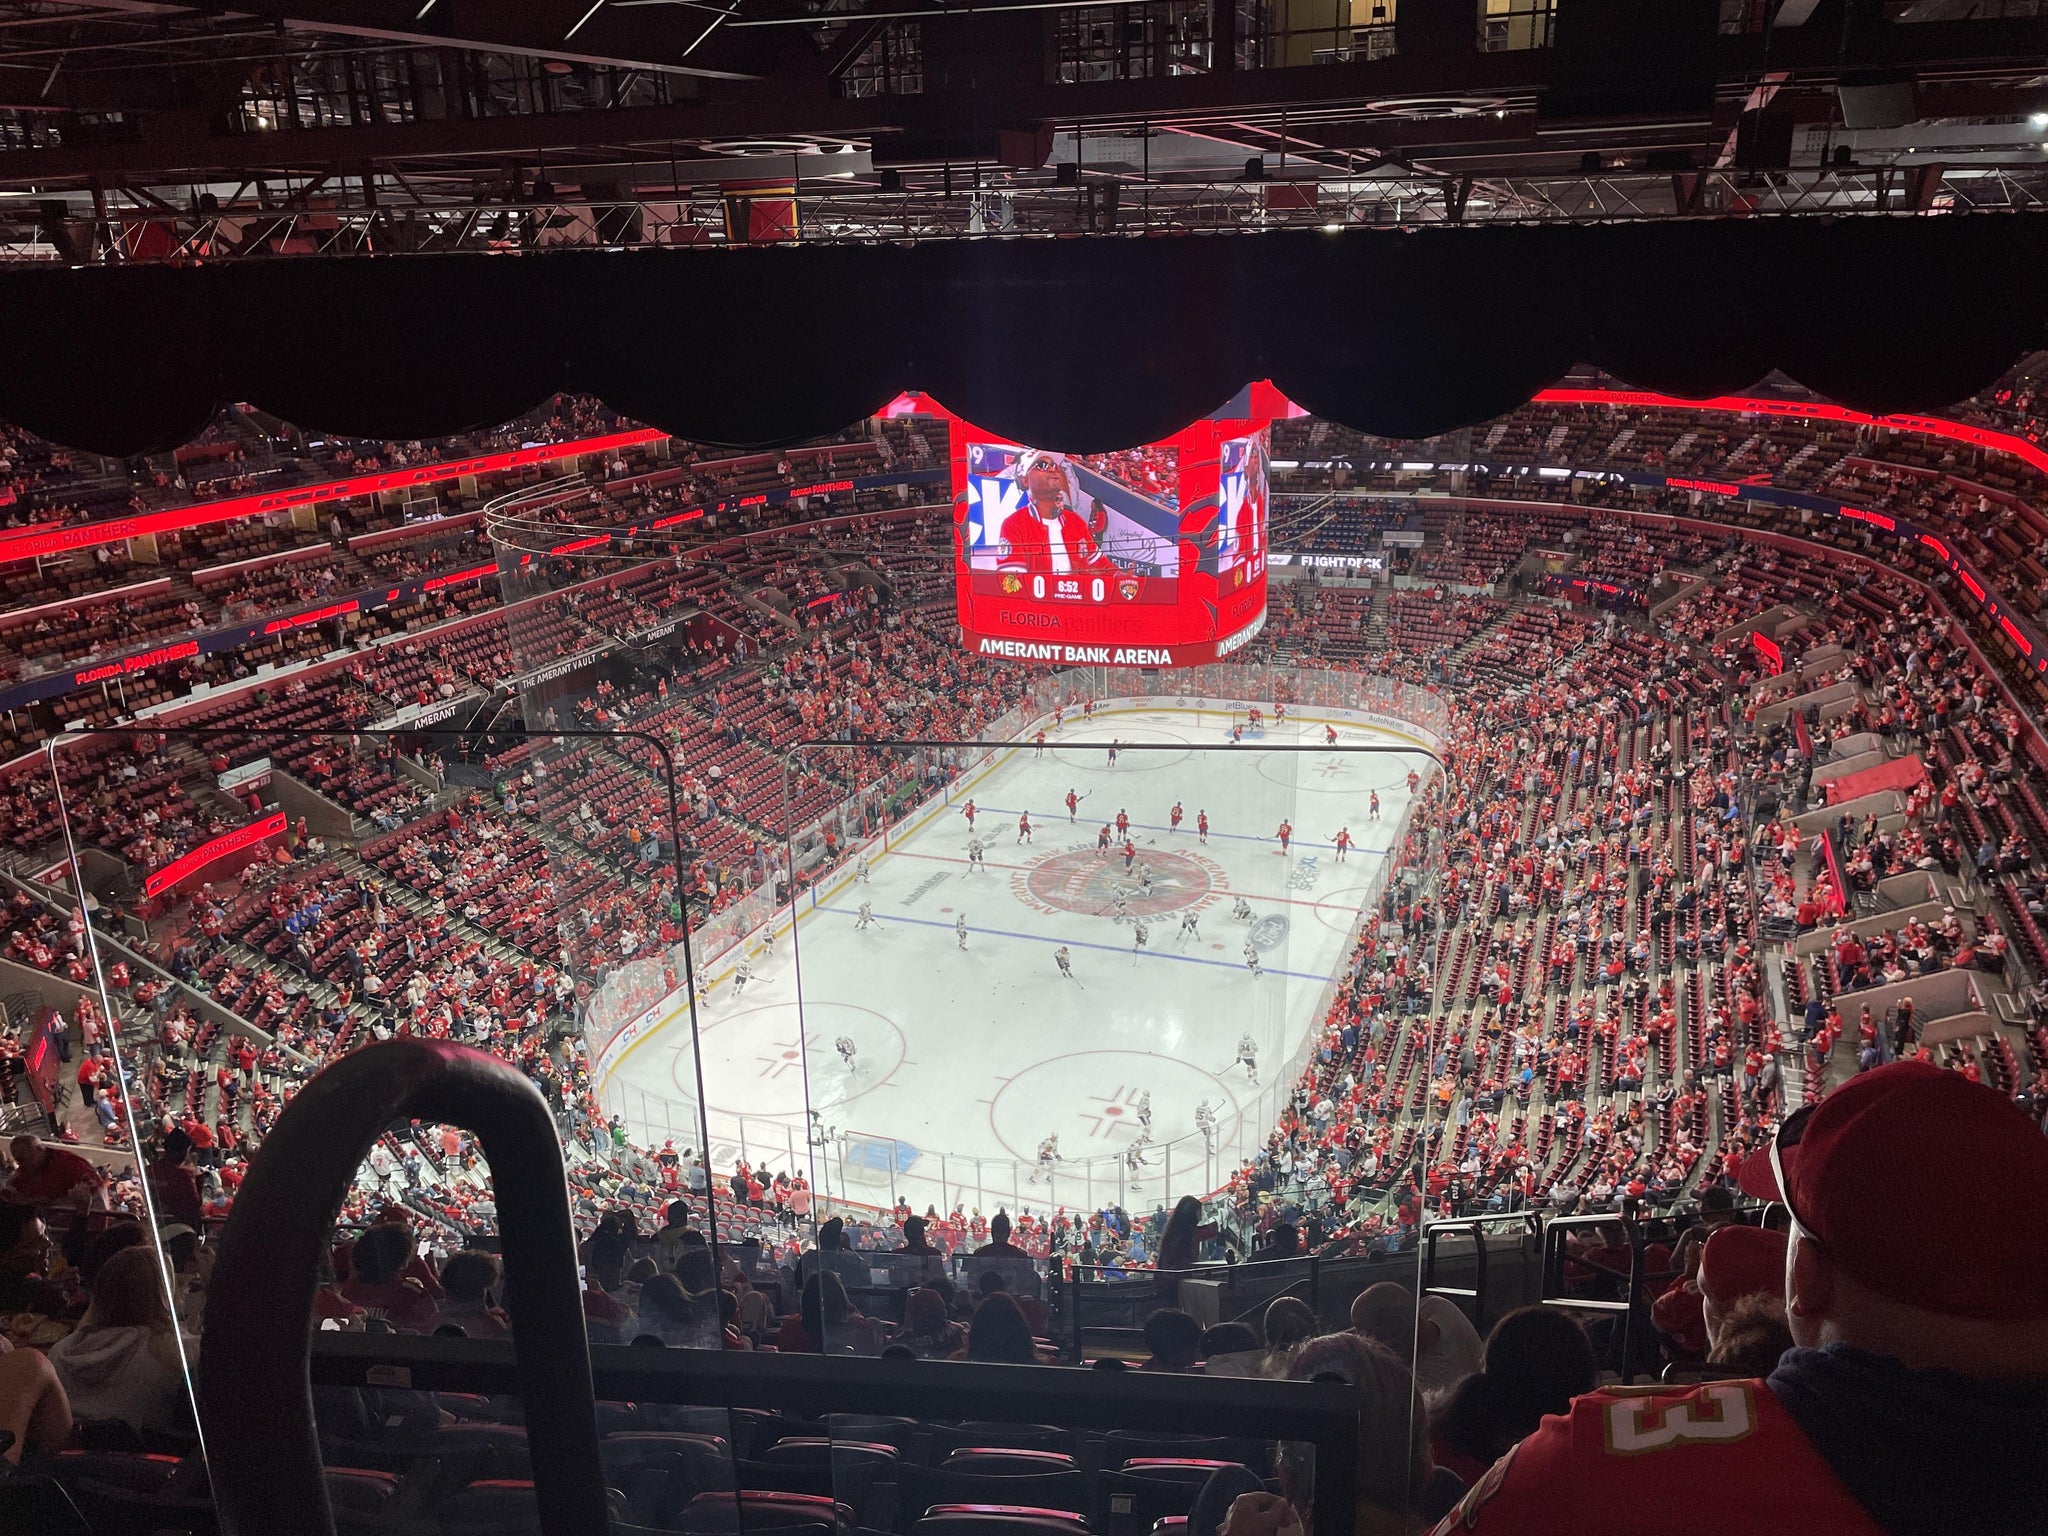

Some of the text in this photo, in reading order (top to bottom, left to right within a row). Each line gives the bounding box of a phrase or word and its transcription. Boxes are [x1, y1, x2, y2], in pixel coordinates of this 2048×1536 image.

[812, 480, 854, 494] PANTHERS
[11, 521, 137, 554] FLORIDA PANTHERS
[1302, 555, 1346, 567] FLIGHT
[1033, 576, 1046, 598] 0
[1092, 578, 1104, 601] 0
[1001, 611, 1060, 628] FLORIDA
[647, 623, 676, 642] AMERANT
[1217, 622, 1256, 657] AMERANT
[75, 640, 200, 685] FLORIDA PANTHERS
[979, 638, 1172, 665] AMERANT BANK ARENA
[522, 654, 597, 689] THE AMERANT VAULT
[414, 706, 457, 730] AMERANT
[1225, 701, 1253, 711] jetBlue
[1368, 714, 1404, 730] AutoNation
[202, 830, 253, 858] PANTHERS
[1023, 841, 1125, 866] BANK AREA
[1009, 871, 1061, 915] AMERANT
[1172, 848, 1230, 914] AMERANT BANK
